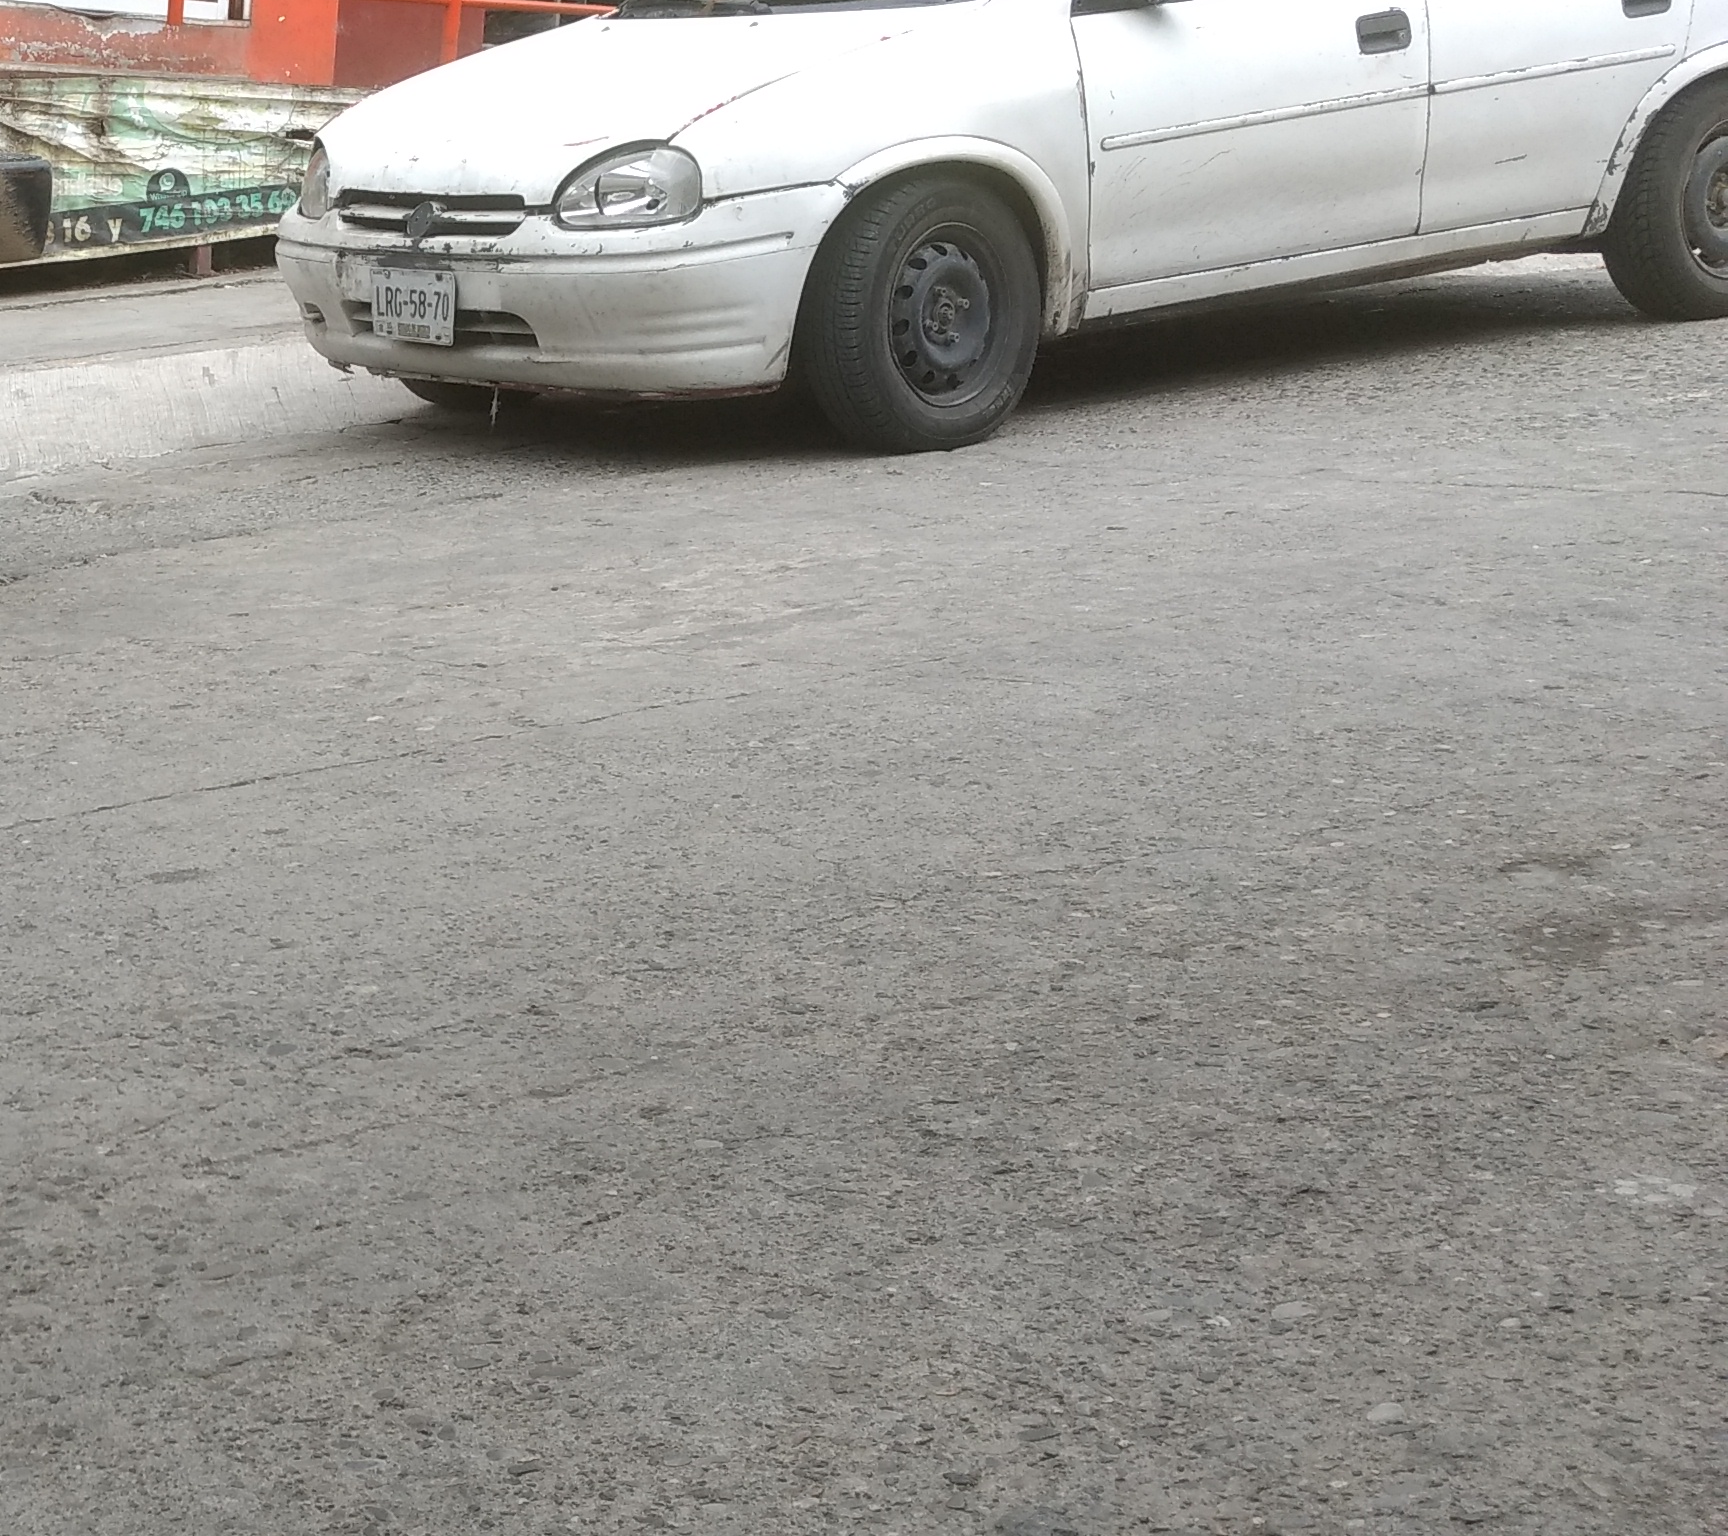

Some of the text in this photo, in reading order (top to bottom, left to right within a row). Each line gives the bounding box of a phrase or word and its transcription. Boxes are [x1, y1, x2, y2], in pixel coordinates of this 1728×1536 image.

[62, 215, 92, 243] 16
[139, 203, 186, 233] 746
[189, 197, 232, 226] 103
[235, 192, 264, 220] 35
[375, 285, 450, 322] LRG-58-70
